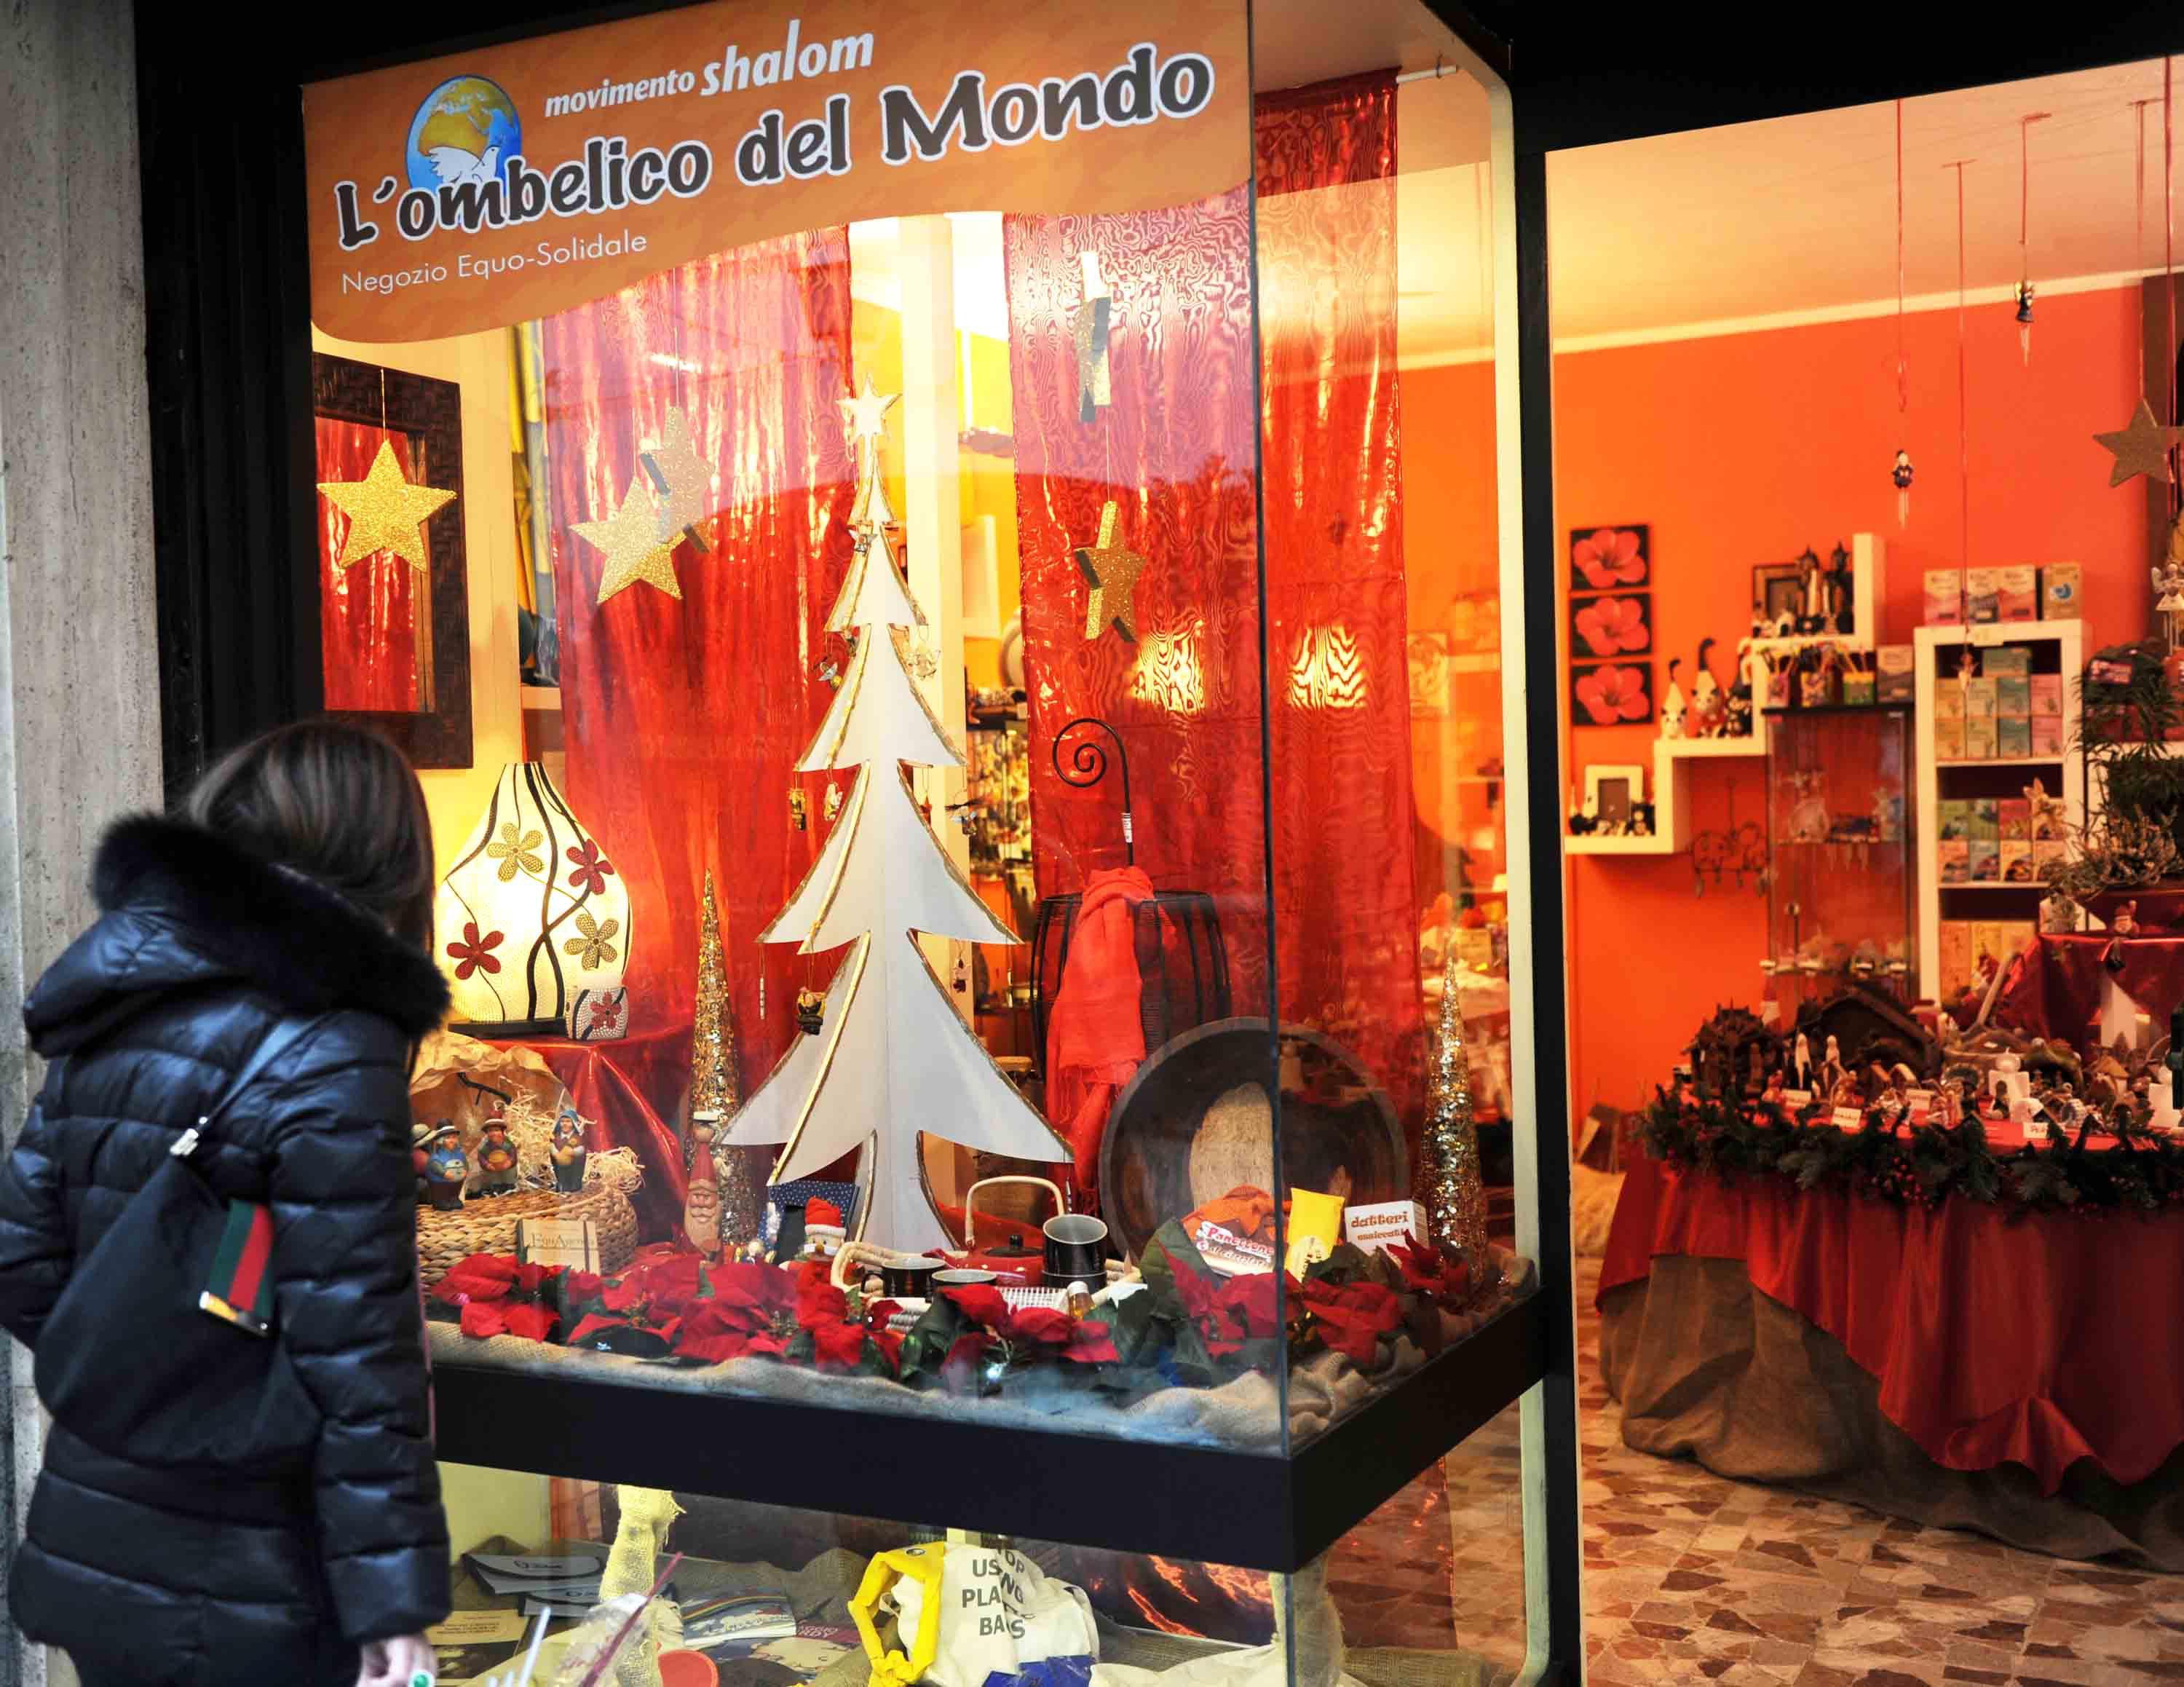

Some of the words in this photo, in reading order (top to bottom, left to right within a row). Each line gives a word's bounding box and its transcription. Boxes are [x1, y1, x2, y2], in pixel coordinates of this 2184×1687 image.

[545, 69, 695, 117] movimento
[700, 18, 874, 97] shalom
[334, 136, 712, 251] L'ombelico
[735, 93, 852, 186] del
[879, 42, 1215, 165] Mondo
[342, 262, 447, 296] Negozio
[458, 229, 647, 280] Equo-Solidale
